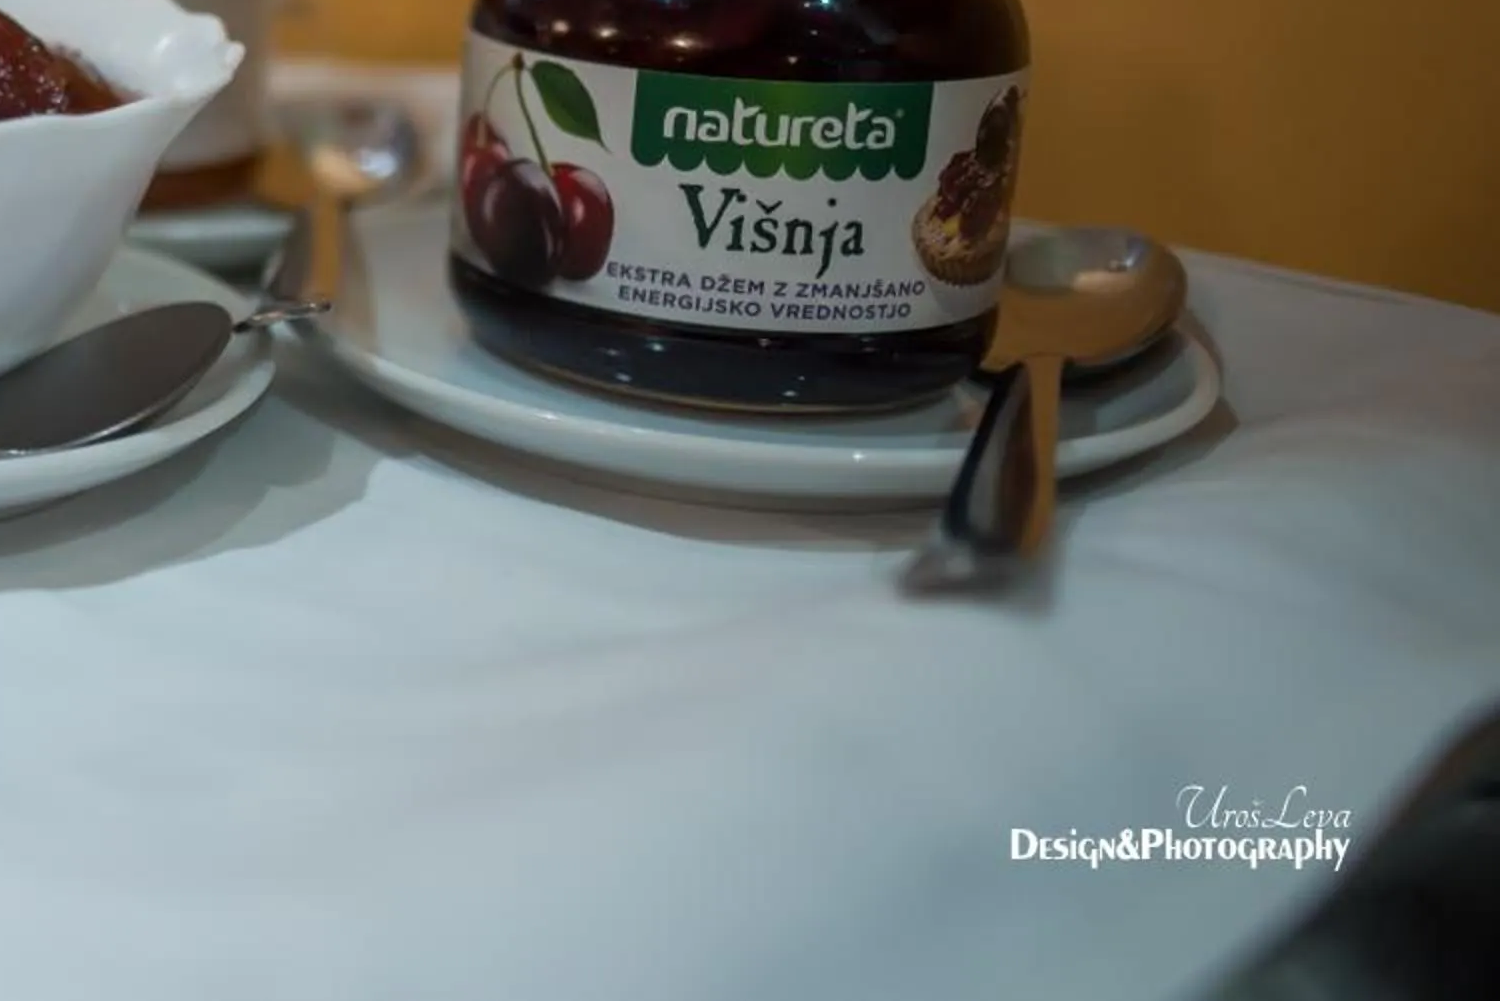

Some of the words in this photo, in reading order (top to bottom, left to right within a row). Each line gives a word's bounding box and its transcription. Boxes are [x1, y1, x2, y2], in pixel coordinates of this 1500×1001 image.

[662, 97, 896, 150] natureta
[679, 184, 865, 278] Višnja
[606, 262, 692, 289] EKSTRA
[700, 270, 765, 296] DŽEM
[774, 282, 788, 297] Z
[795, 277, 926, 299] ZMANJŠANO
[617, 286, 761, 317] ENERGIJSKO
[771, 302, 912, 320] VREDNOSTJO
